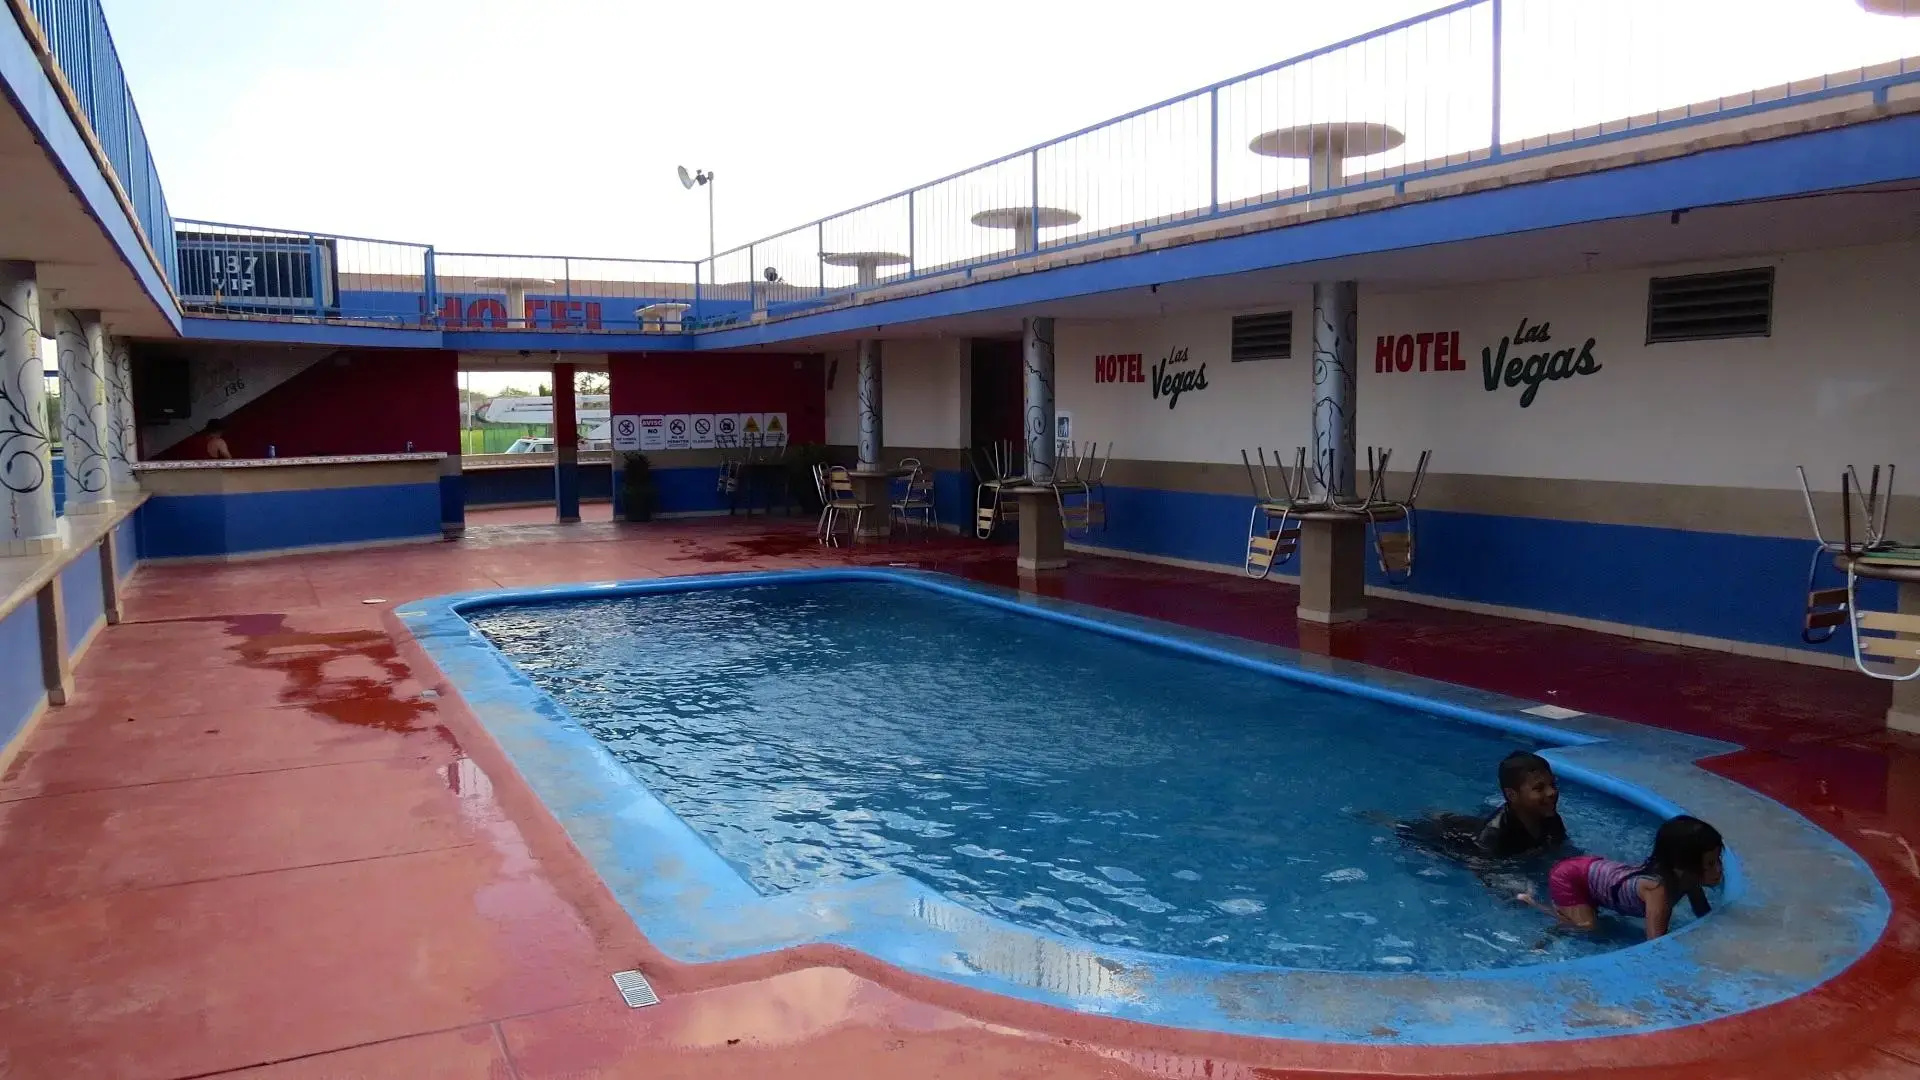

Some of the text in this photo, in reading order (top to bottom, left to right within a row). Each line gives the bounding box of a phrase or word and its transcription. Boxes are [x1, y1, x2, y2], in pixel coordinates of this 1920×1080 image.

[211, 278, 256, 290] VIP
[1513, 317, 1551, 345] Las
[1168, 345, 1188, 365] Las
[1095, 353, 1208, 410] HOTEL Vegas
[1375, 331, 1602, 408] HOTEL Vegas
